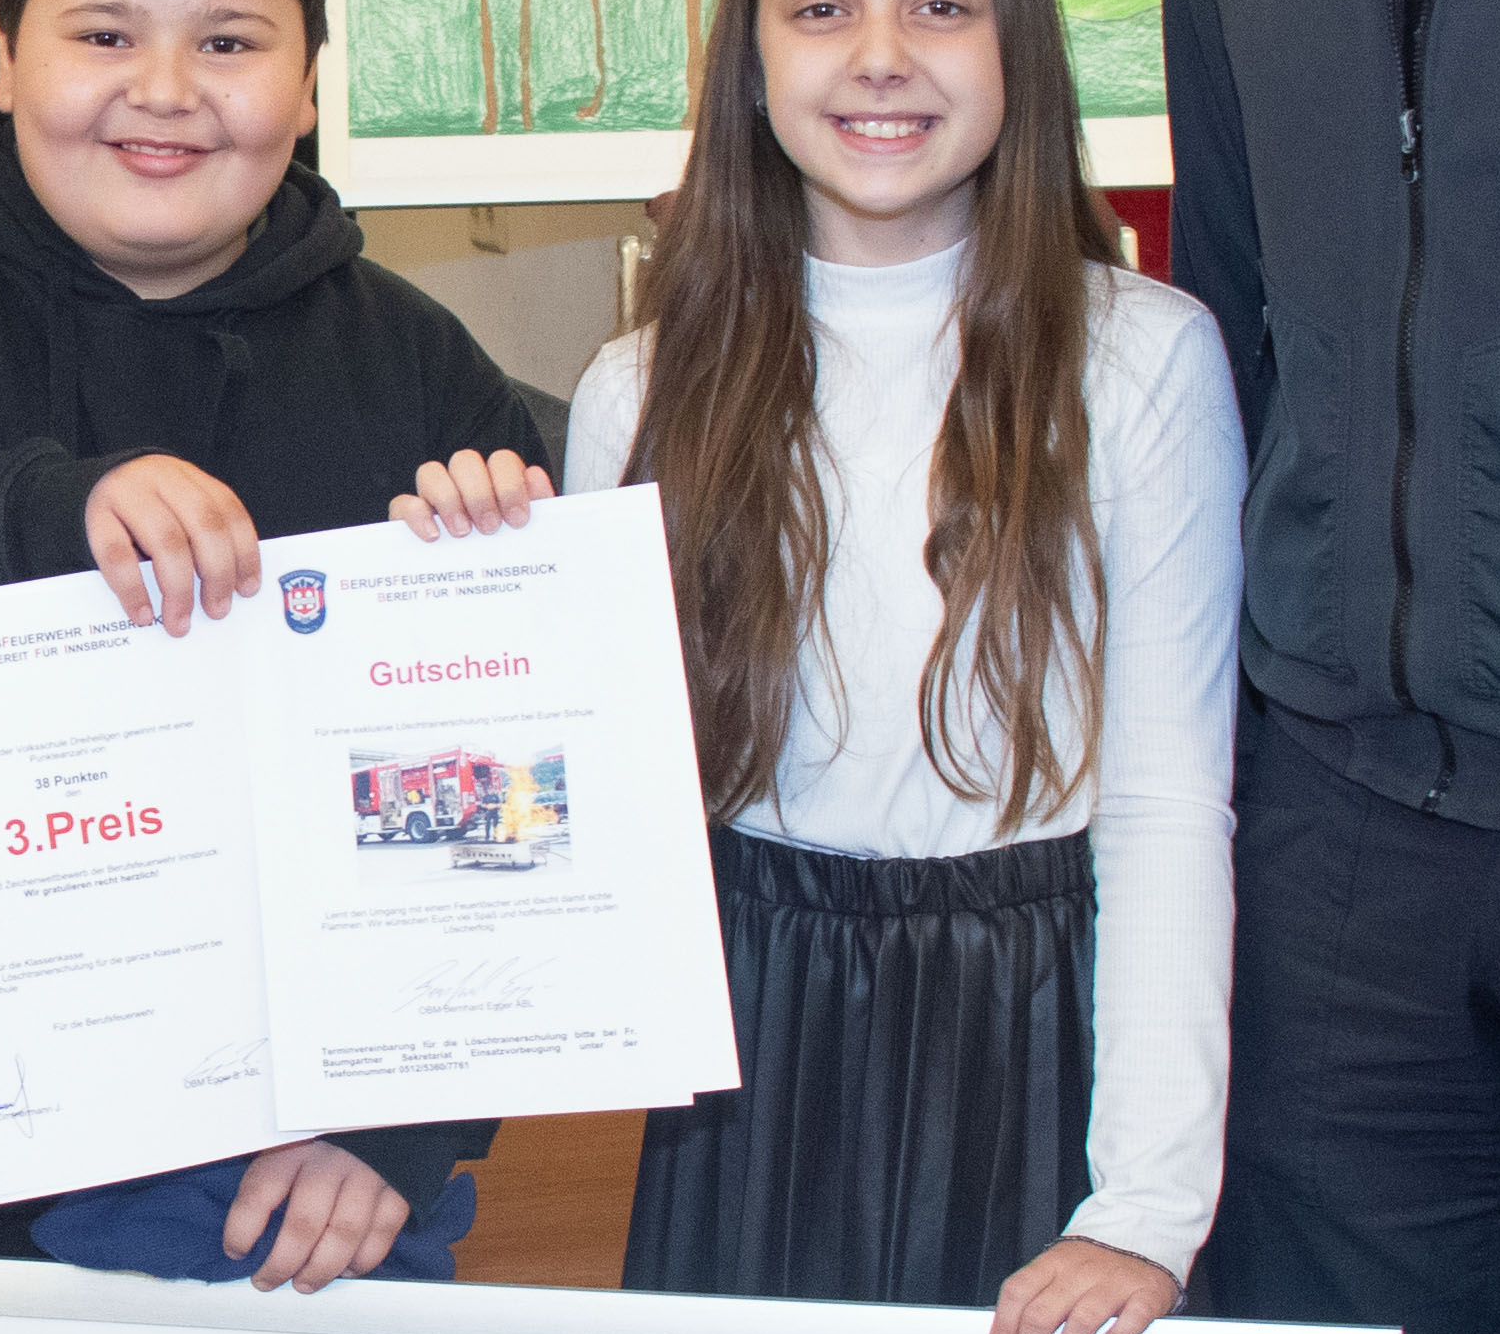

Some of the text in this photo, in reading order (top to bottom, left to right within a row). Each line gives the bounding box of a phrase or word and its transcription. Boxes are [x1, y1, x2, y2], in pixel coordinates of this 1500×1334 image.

[339, 569, 474, 590] BERUFSFEUERWEHR
[481, 562, 557, 578] INNSBRUCK
[377, 581, 522, 602] BEREIT FÜR INNSBRUCK
[88, 614, 163, 635] INNSBRK
[34, 646, 58, 658] FÜR
[63, 636, 130, 653] INNSBRUCK
[369, 651, 530, 686] Gutschein
[34, 770, 108, 790] 38 Punkten
[4, 800, 163, 855] 3.Preis
